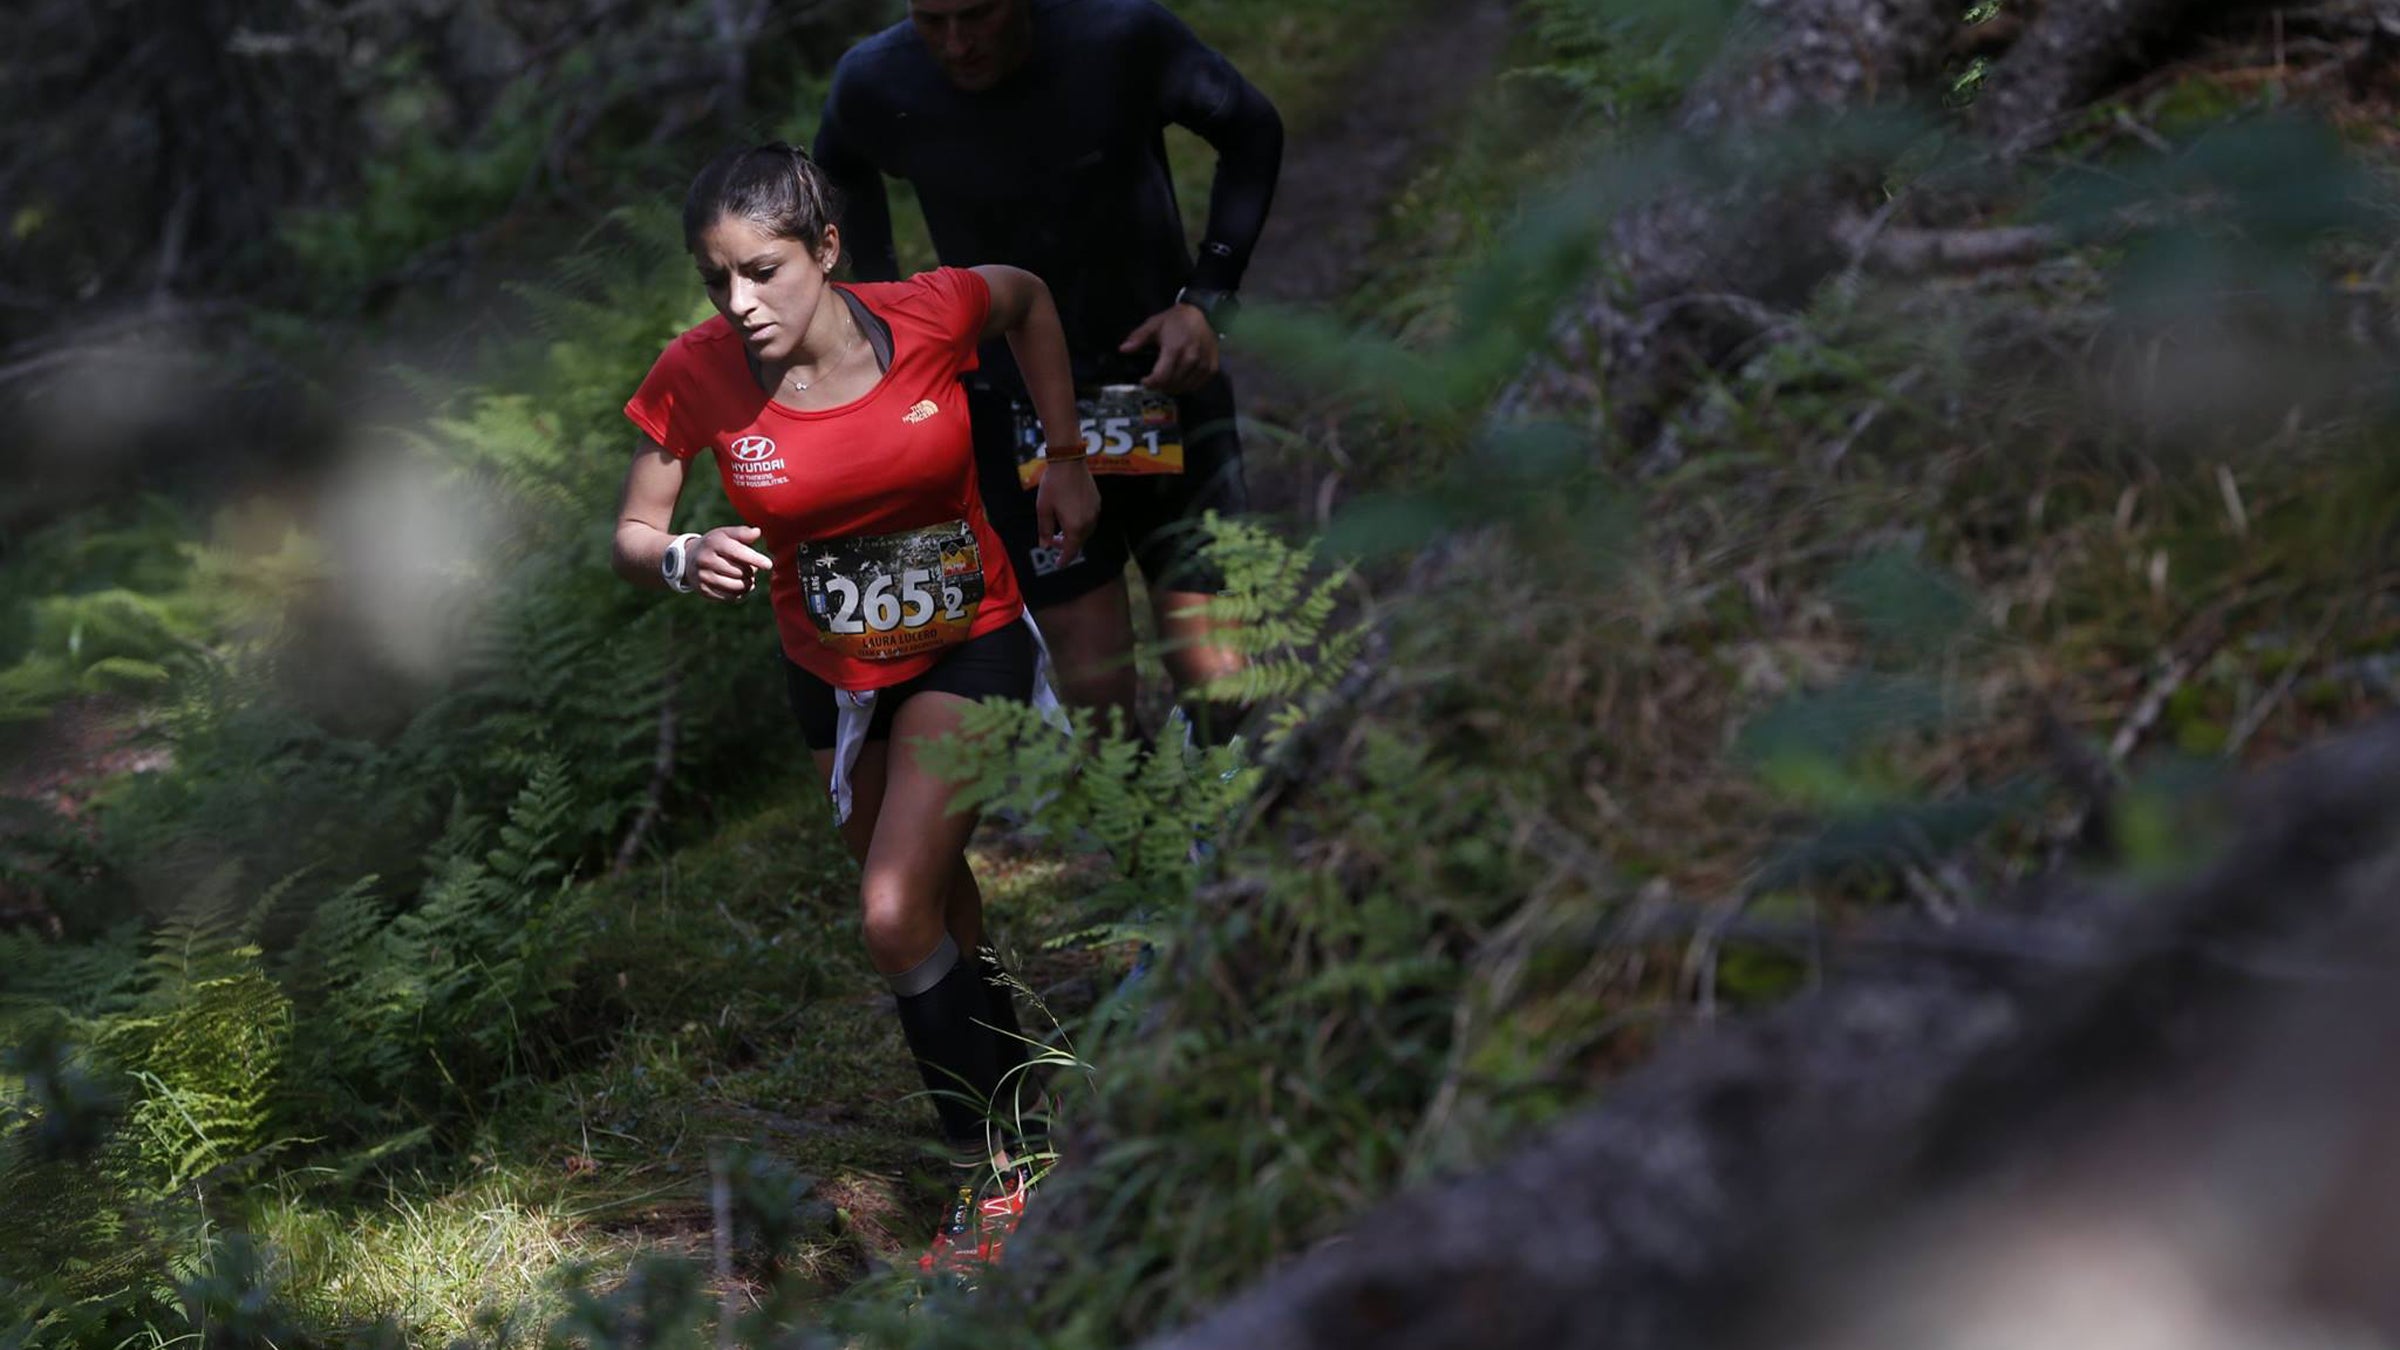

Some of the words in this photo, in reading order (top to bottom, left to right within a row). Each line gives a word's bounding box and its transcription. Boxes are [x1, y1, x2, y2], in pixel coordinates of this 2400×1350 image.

[731, 458, 785, 473] HYUNDAI
[825, 569, 935, 634] 265
[942, 585, 966, 620] 2
[863, 634, 897, 649] LAURA
[899, 629, 937, 644] LUCERO
